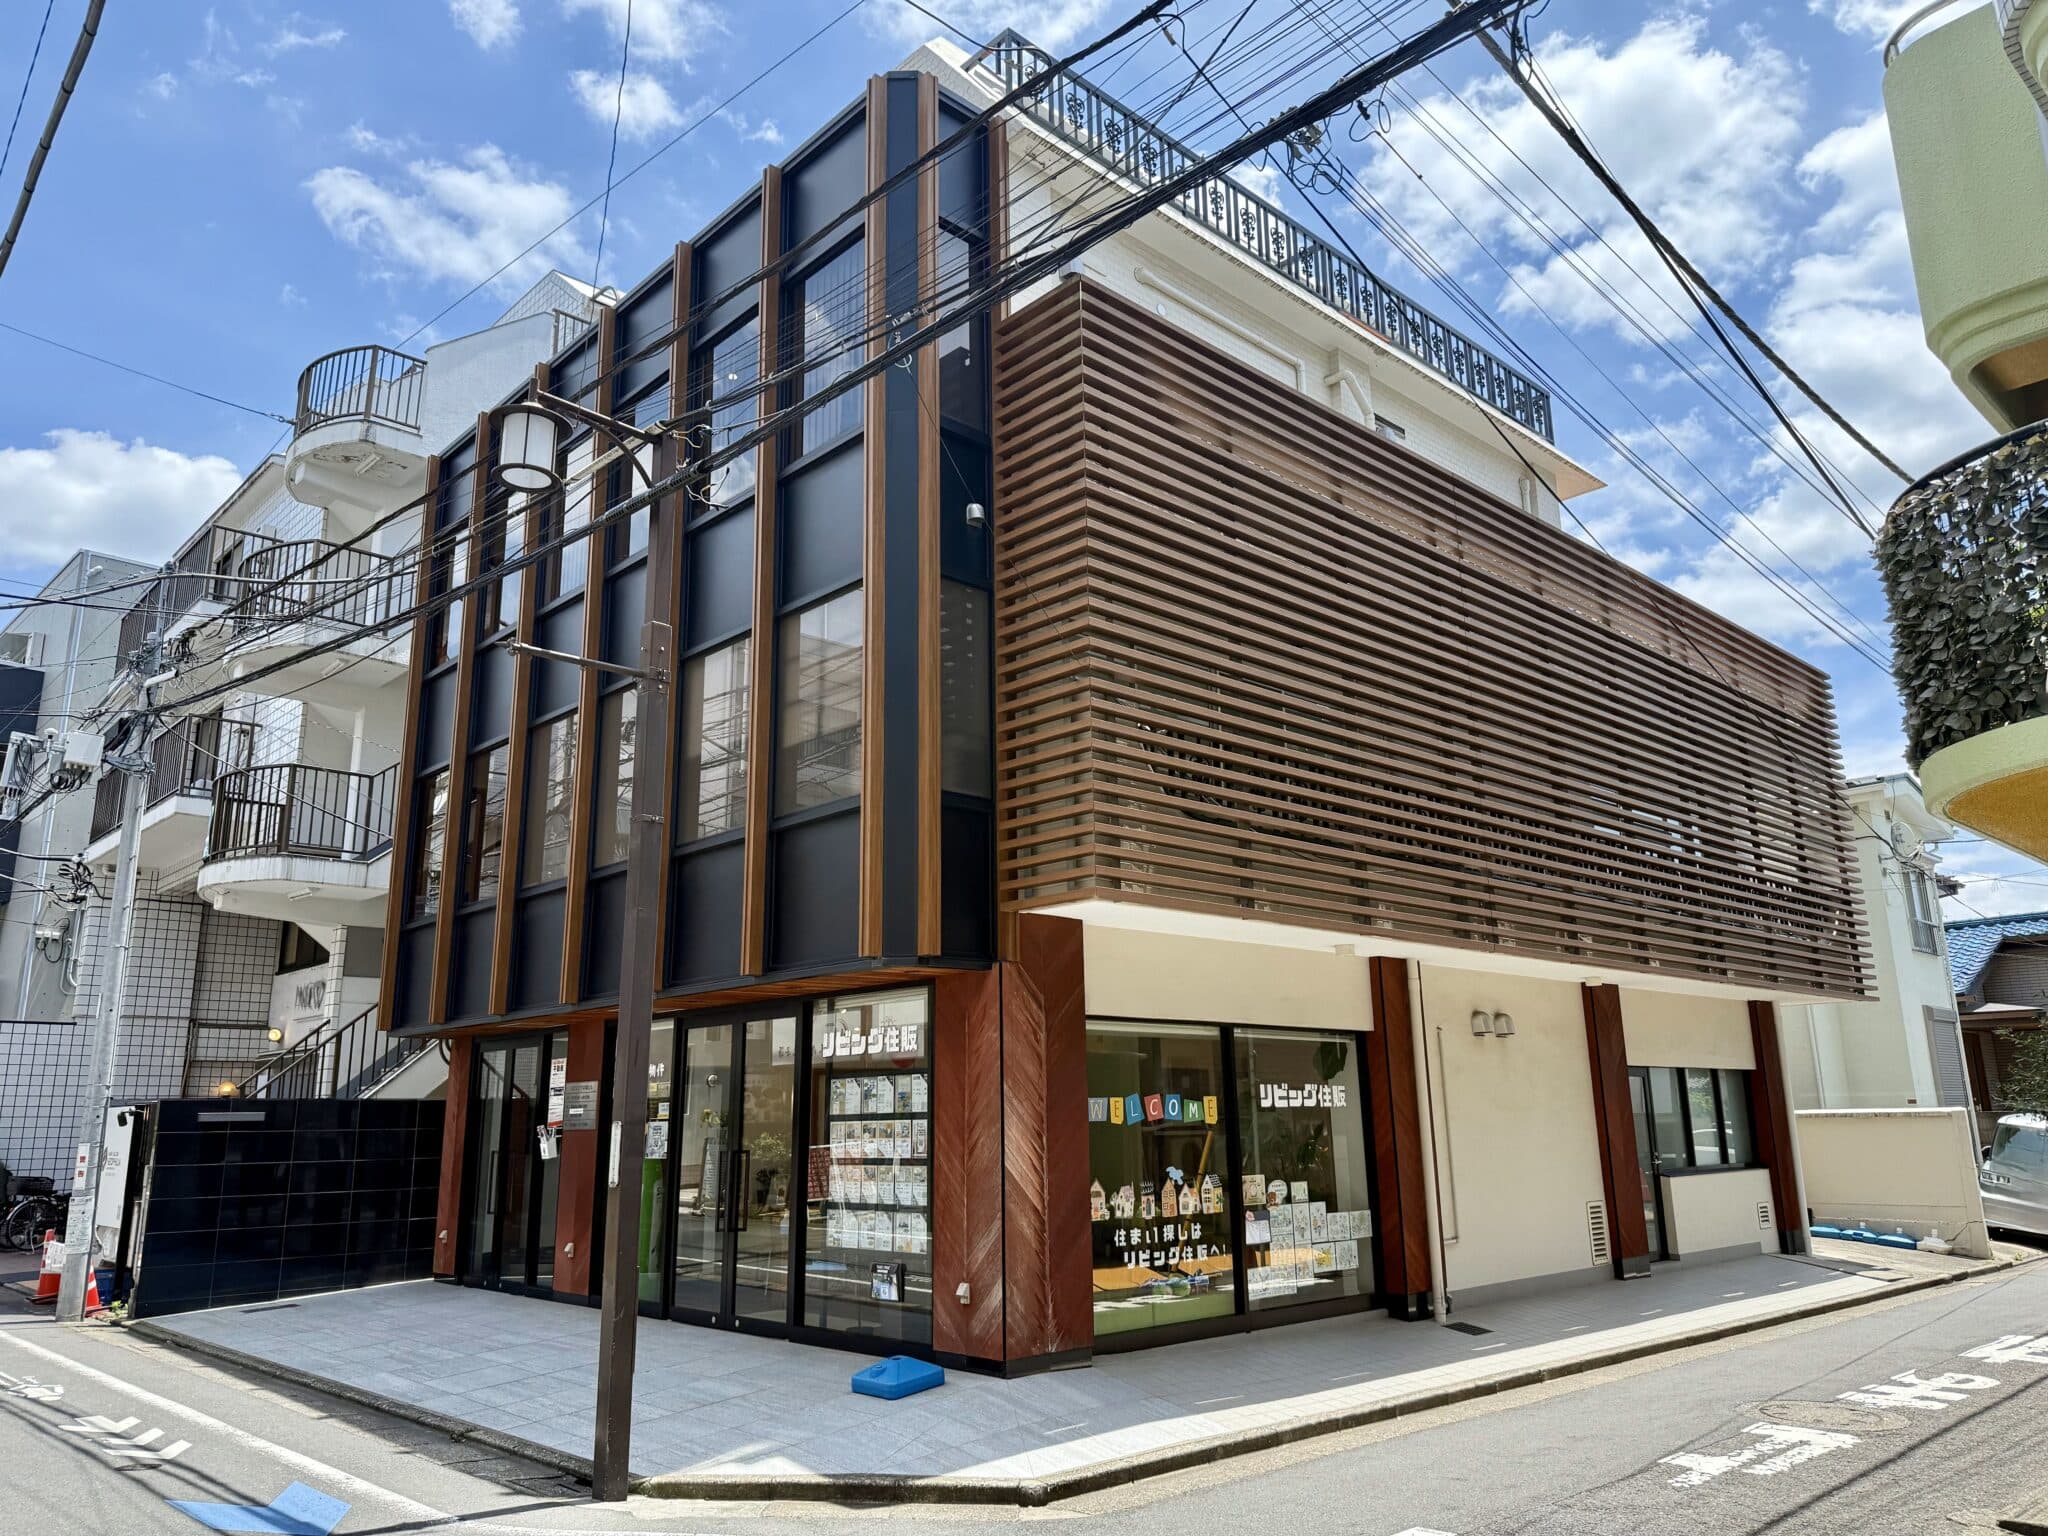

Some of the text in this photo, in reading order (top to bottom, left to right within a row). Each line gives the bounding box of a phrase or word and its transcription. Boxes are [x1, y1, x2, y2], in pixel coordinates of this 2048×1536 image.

[822, 1024, 918, 1058] リビング住販
[1259, 1082, 1347, 1108] リビング住販
[1088, 1097, 1215, 1121] WELCOME
[1113, 1222, 1202, 1247] 住まい探しは
